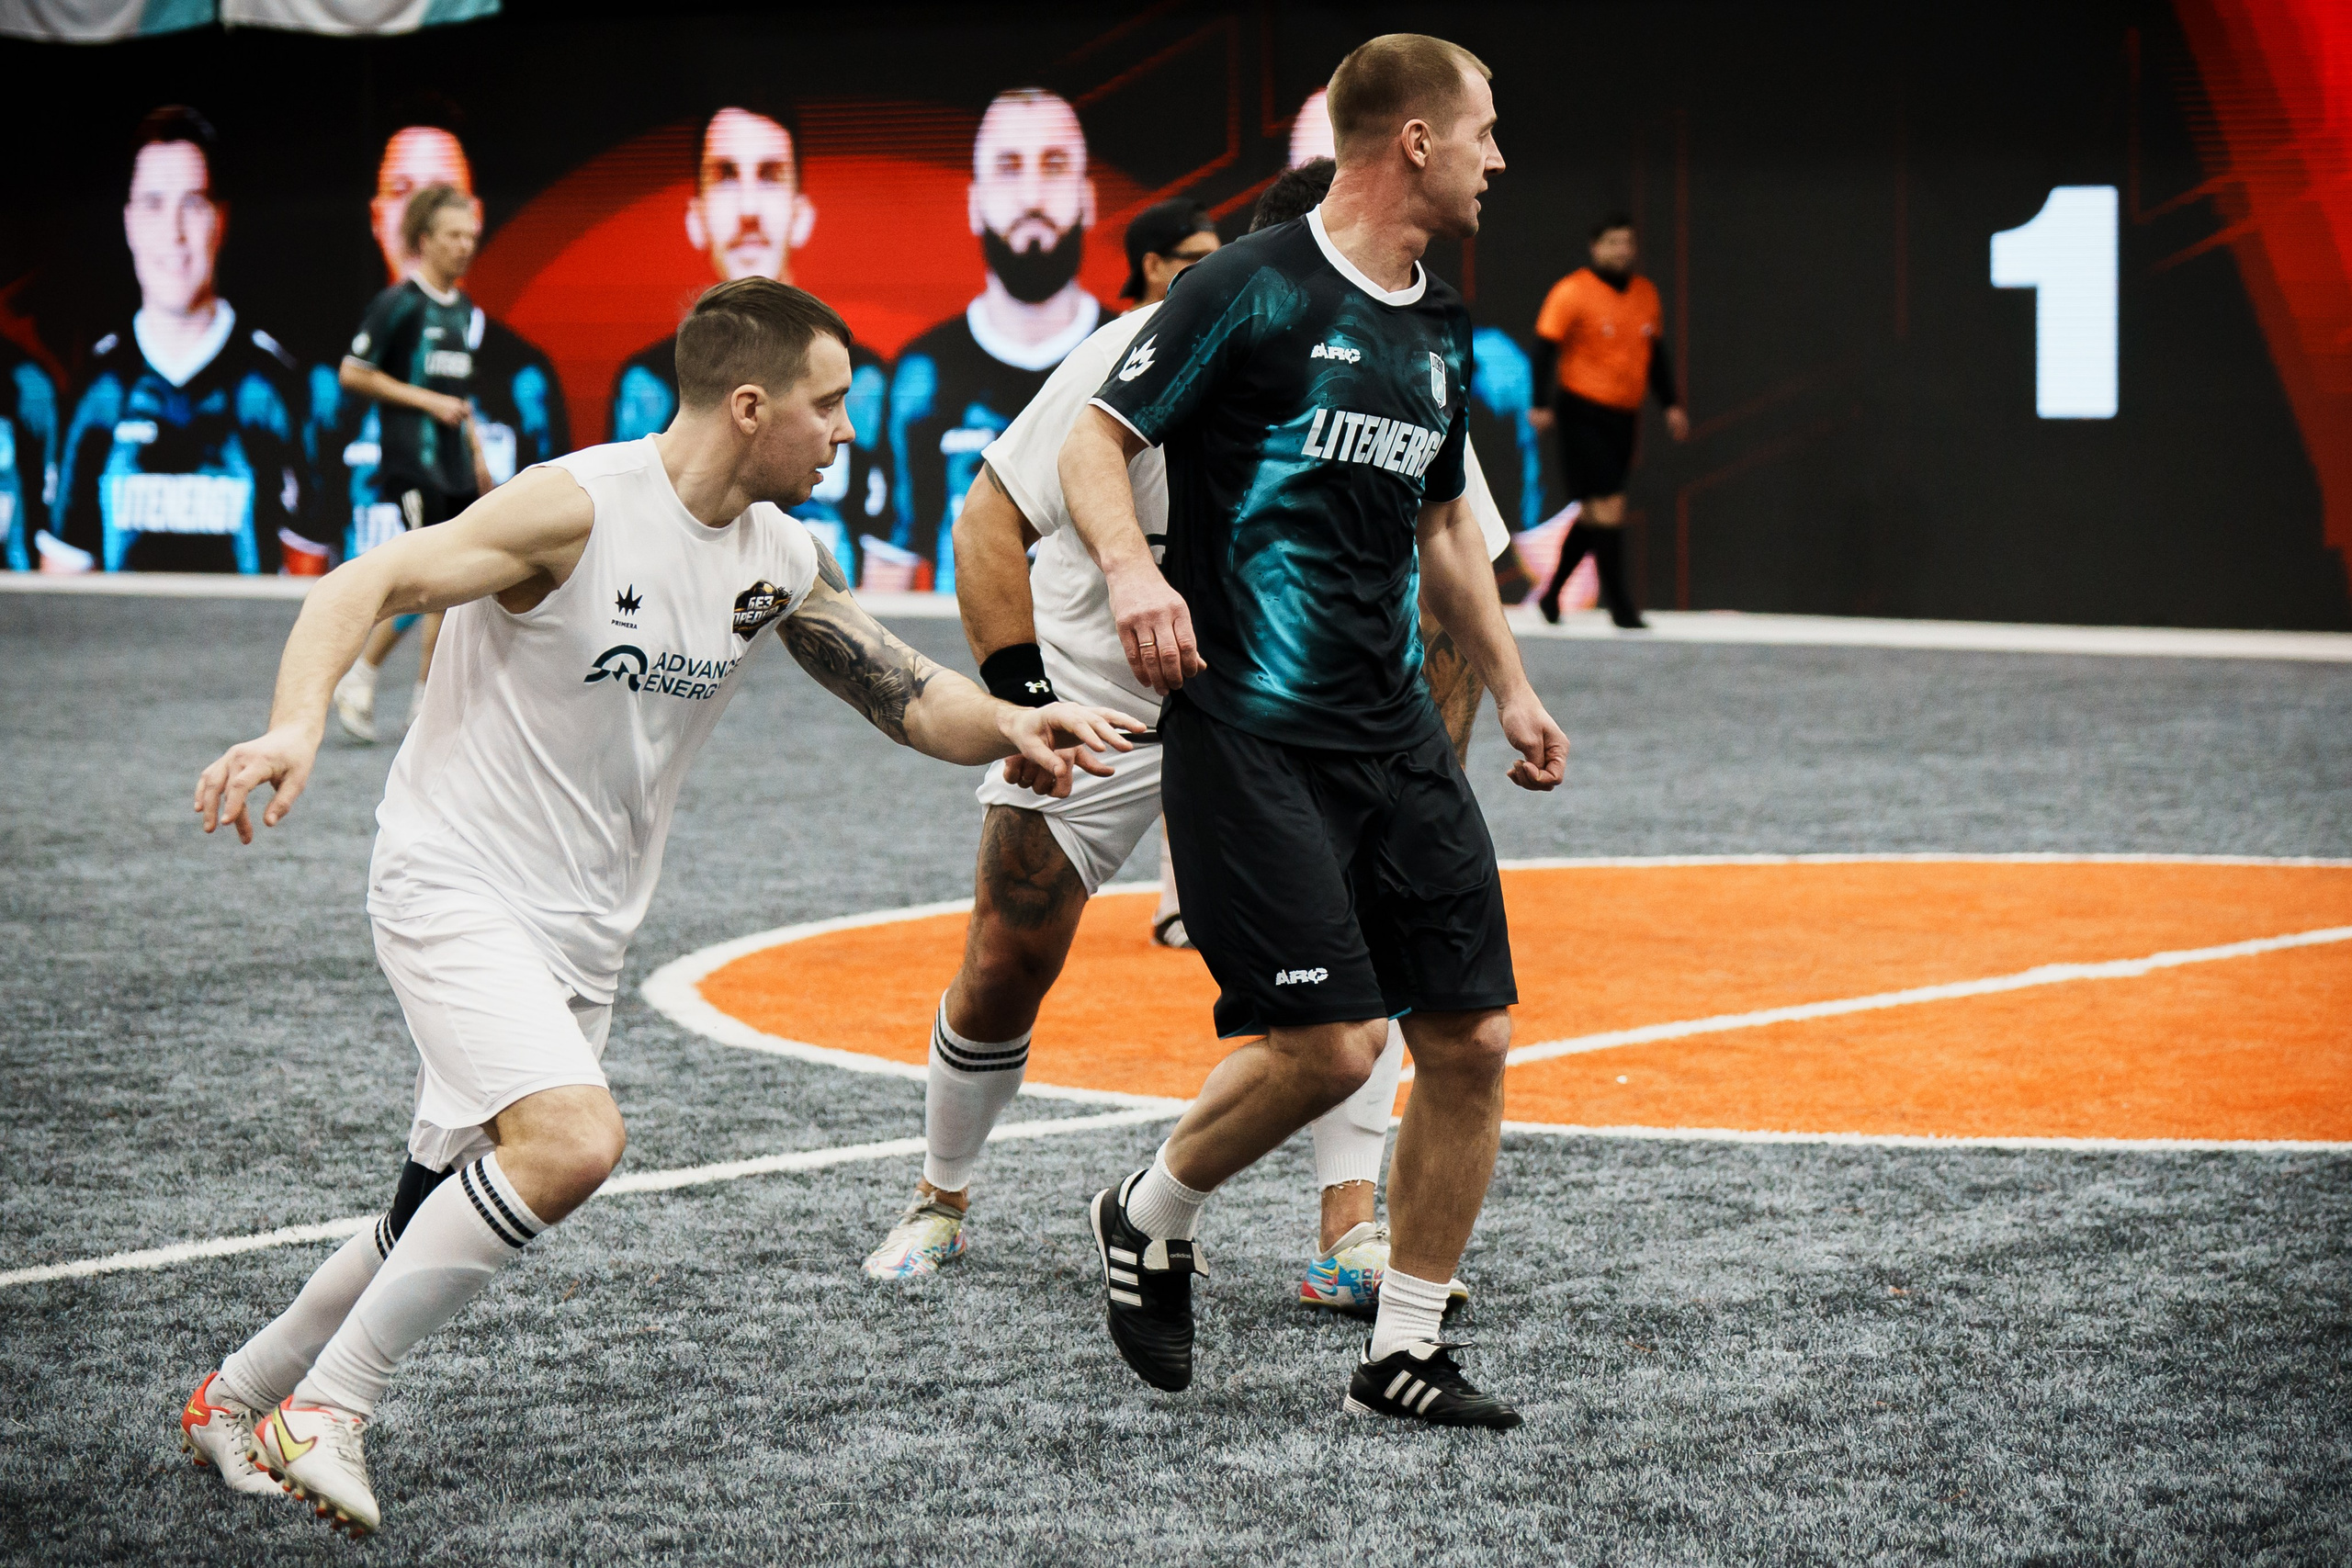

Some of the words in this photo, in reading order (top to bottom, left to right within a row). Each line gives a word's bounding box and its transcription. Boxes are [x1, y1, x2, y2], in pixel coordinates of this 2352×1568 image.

[1990, 185, 2119, 419] 1
[1310, 343, 1362, 364] ARC
[747, 595, 775, 611] БЕЗ
[611, 619, 638, 629] PRIMERA
[651, 651, 742, 679] ADVANC
[643, 673, 721, 700] ENERG
[1275, 967, 1329, 986] ARC
